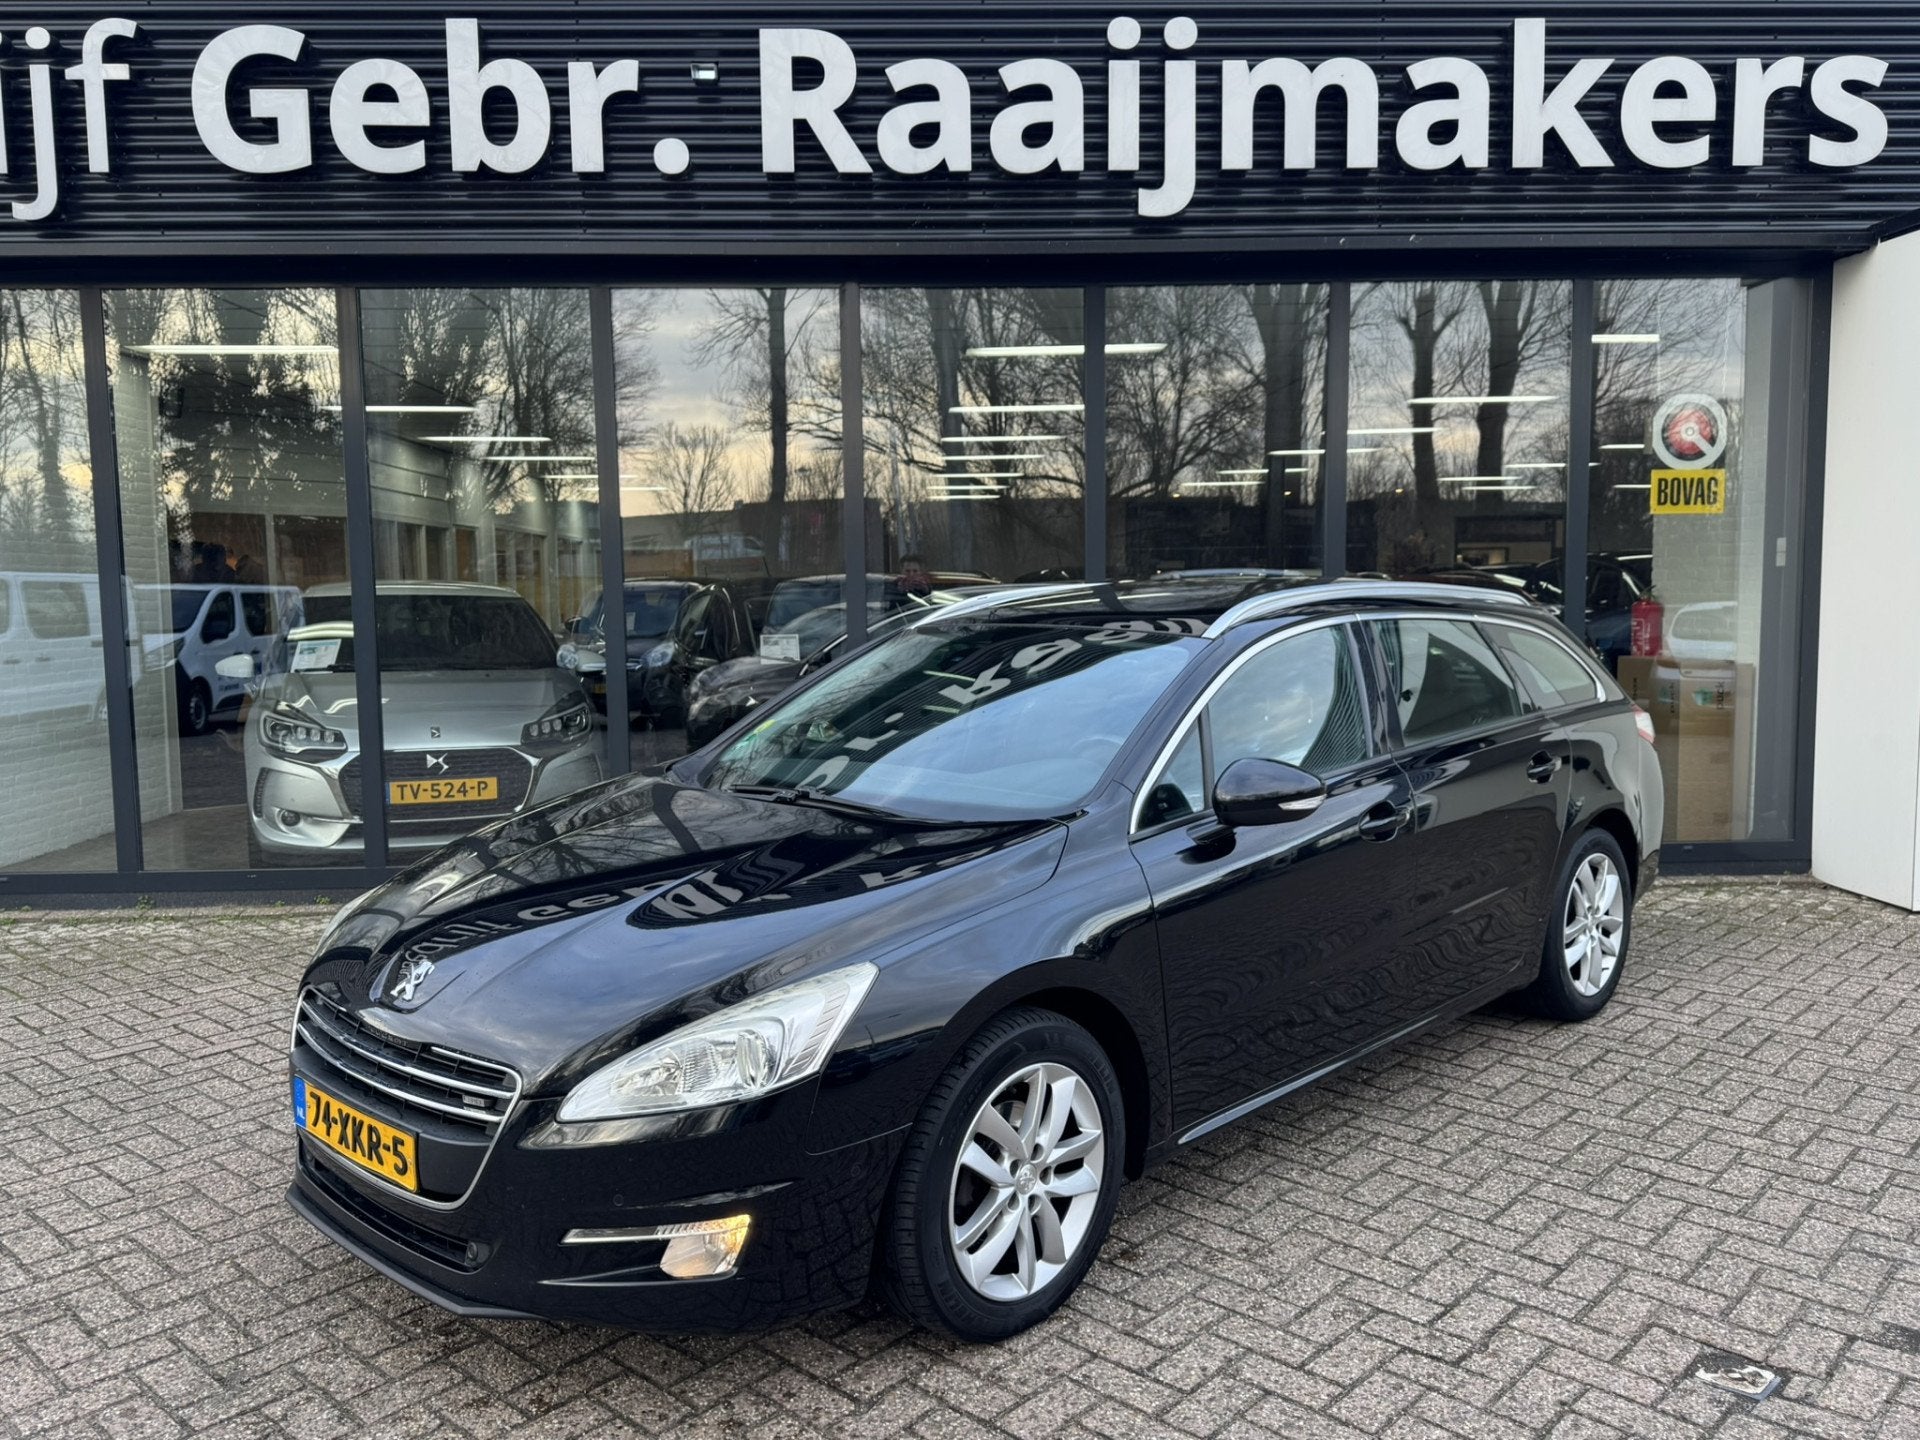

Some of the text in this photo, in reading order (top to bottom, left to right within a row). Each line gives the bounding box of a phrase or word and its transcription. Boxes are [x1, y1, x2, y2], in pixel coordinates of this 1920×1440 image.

[190, 17, 690, 175] Gebr.
[758, 15, 1890, 218] Raaijmakers
[1656, 476, 1719, 506] BOVAG
[396, 780, 489, 801] TV-524-P
[309, 1091, 409, 1177] 74-XKR-5
